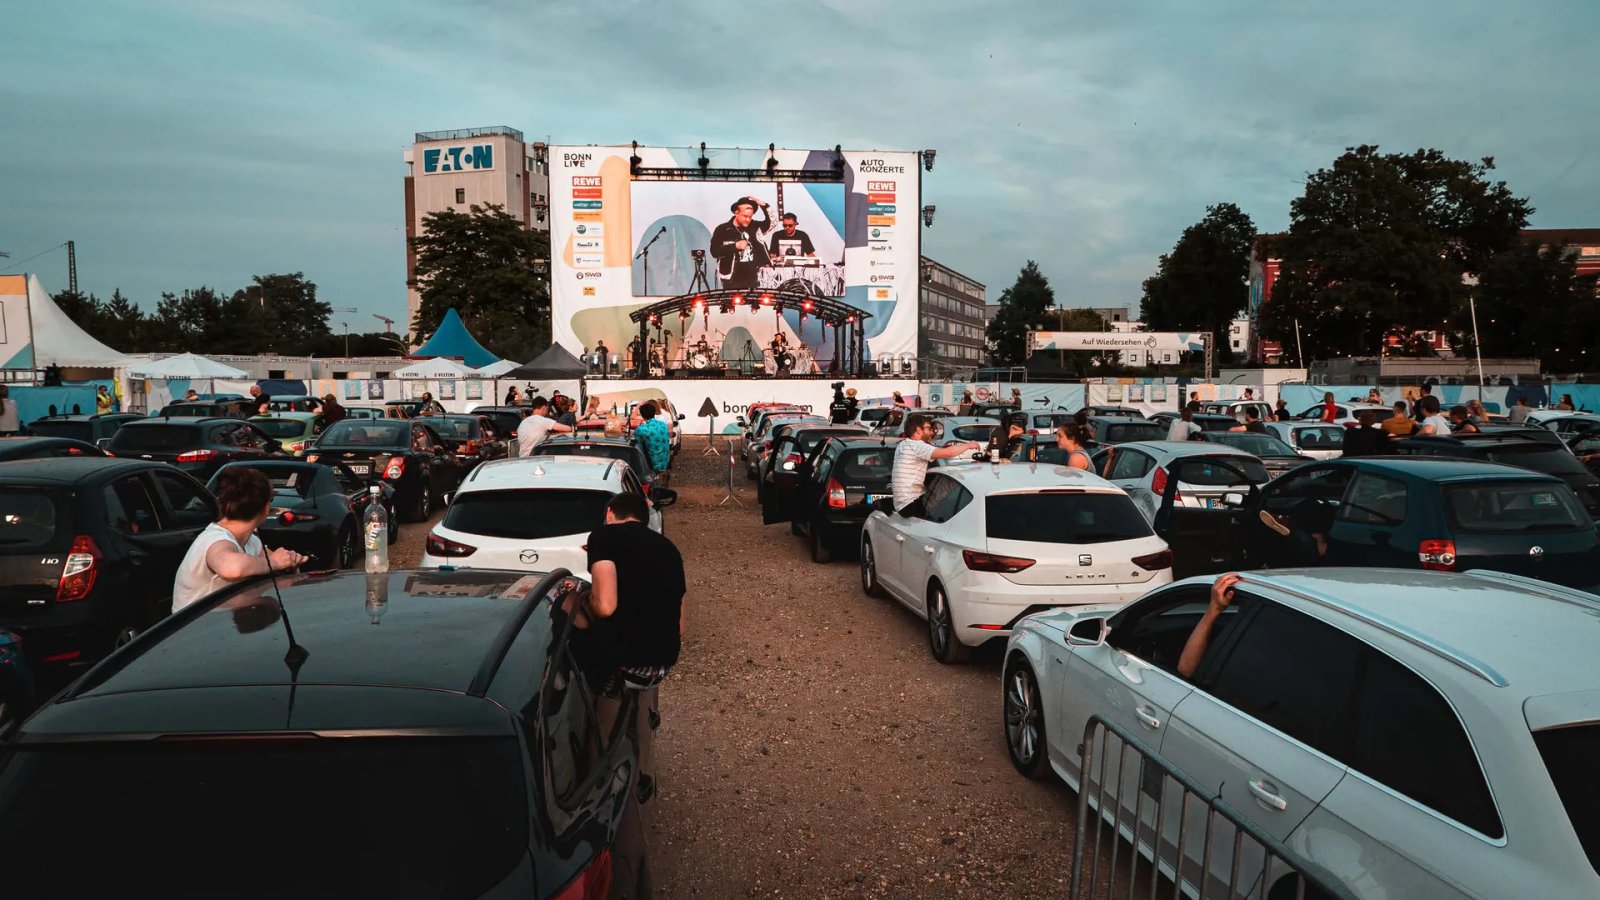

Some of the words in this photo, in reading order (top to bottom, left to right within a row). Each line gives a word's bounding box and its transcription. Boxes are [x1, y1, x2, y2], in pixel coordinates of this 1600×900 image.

[424, 145, 492, 173] EATON
[564, 153, 592, 161] BONN
[573, 177, 601, 185] REWE
[868, 182, 895, 190] REWE
